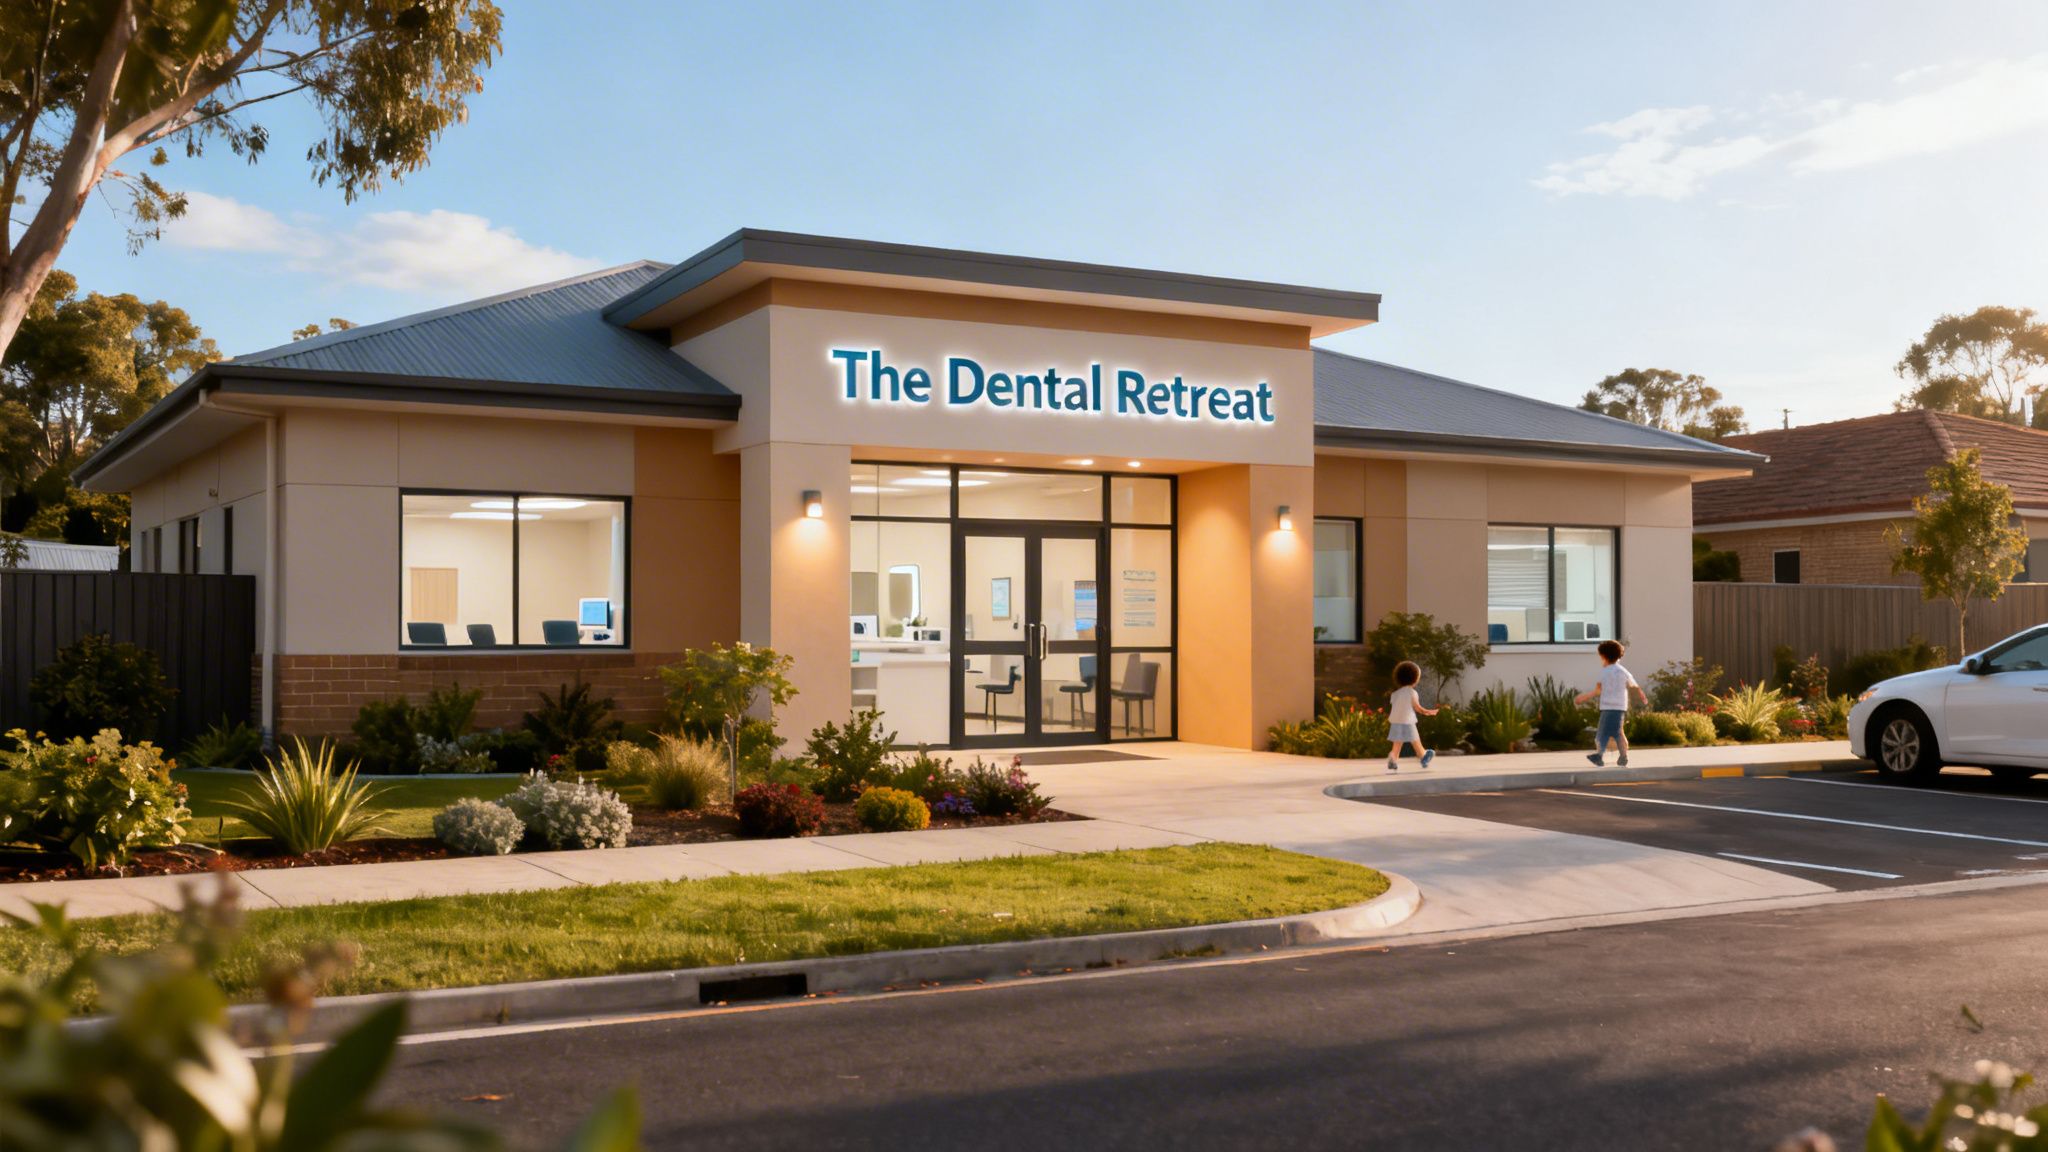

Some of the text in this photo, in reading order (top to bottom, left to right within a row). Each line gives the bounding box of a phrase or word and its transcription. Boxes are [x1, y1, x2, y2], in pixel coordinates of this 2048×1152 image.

[832, 349, 1275, 422] The Dental Retreat
